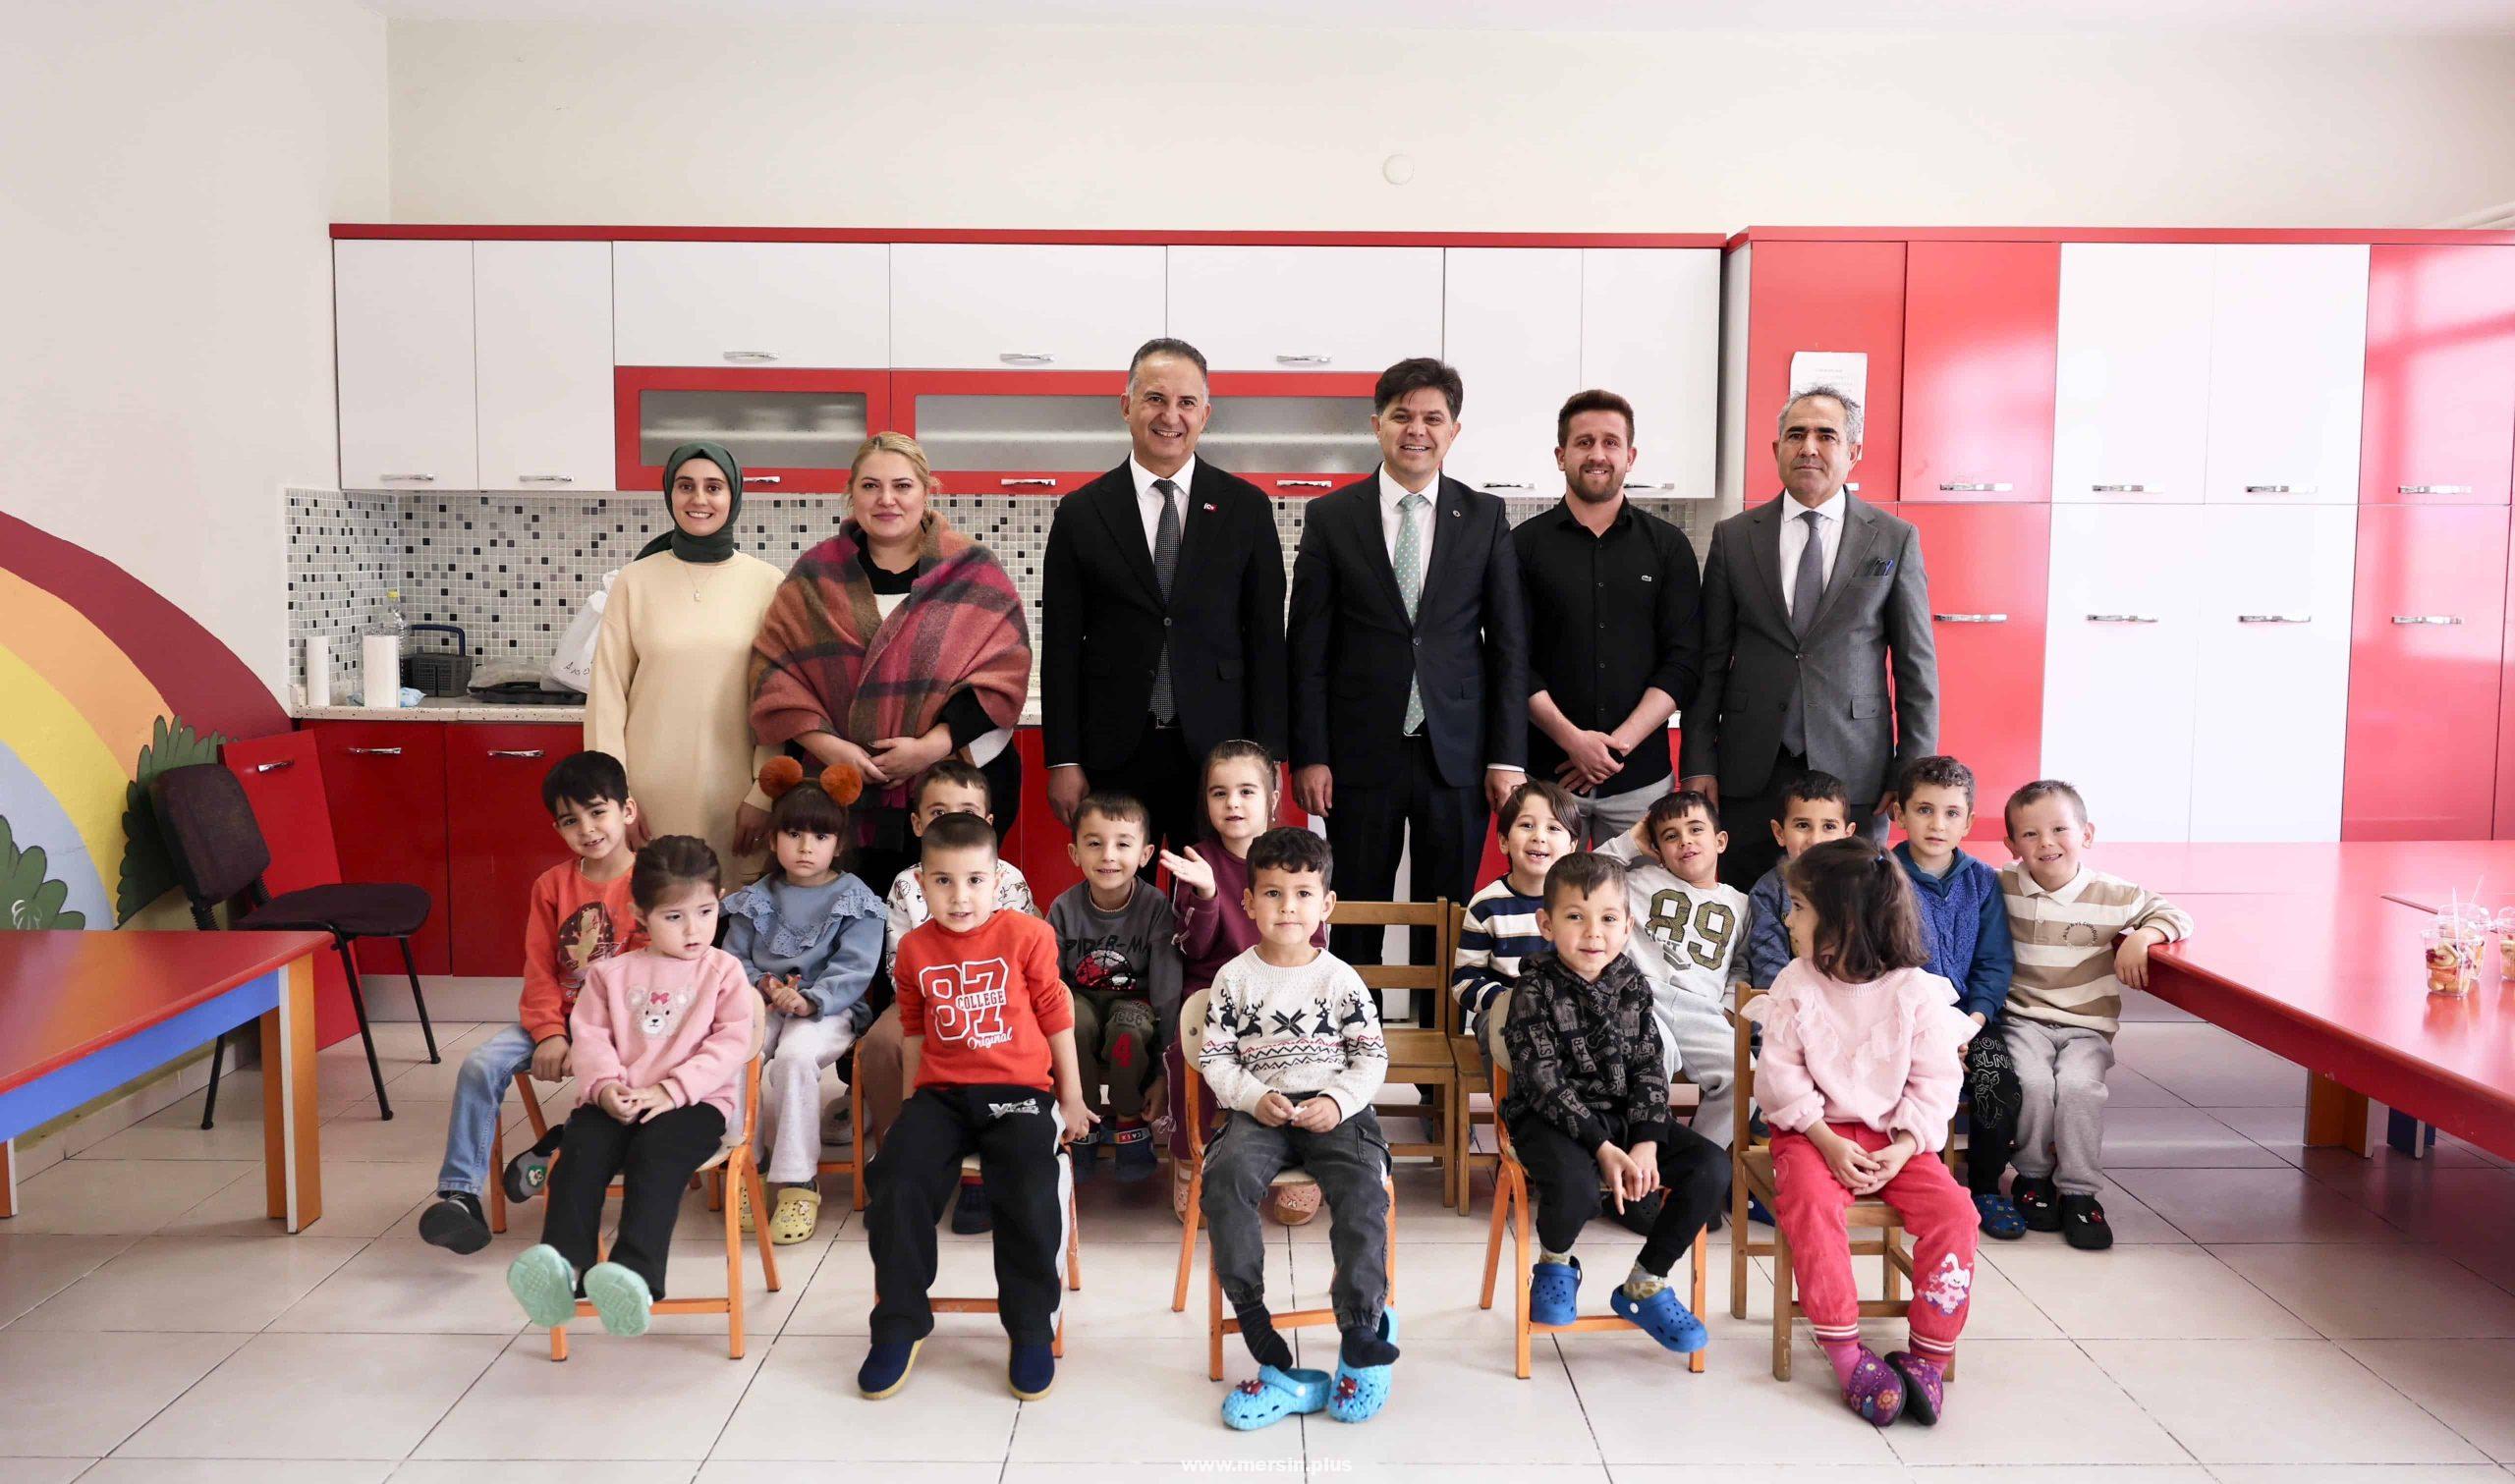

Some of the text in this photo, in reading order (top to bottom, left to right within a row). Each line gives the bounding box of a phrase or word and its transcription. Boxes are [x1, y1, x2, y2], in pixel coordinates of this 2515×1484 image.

[1645, 888, 1736, 971] 89
[919, 957, 1009, 1041] 87
[956, 989, 1005, 1010] COLLEGE
[967, 1026, 1013, 1050] Original
